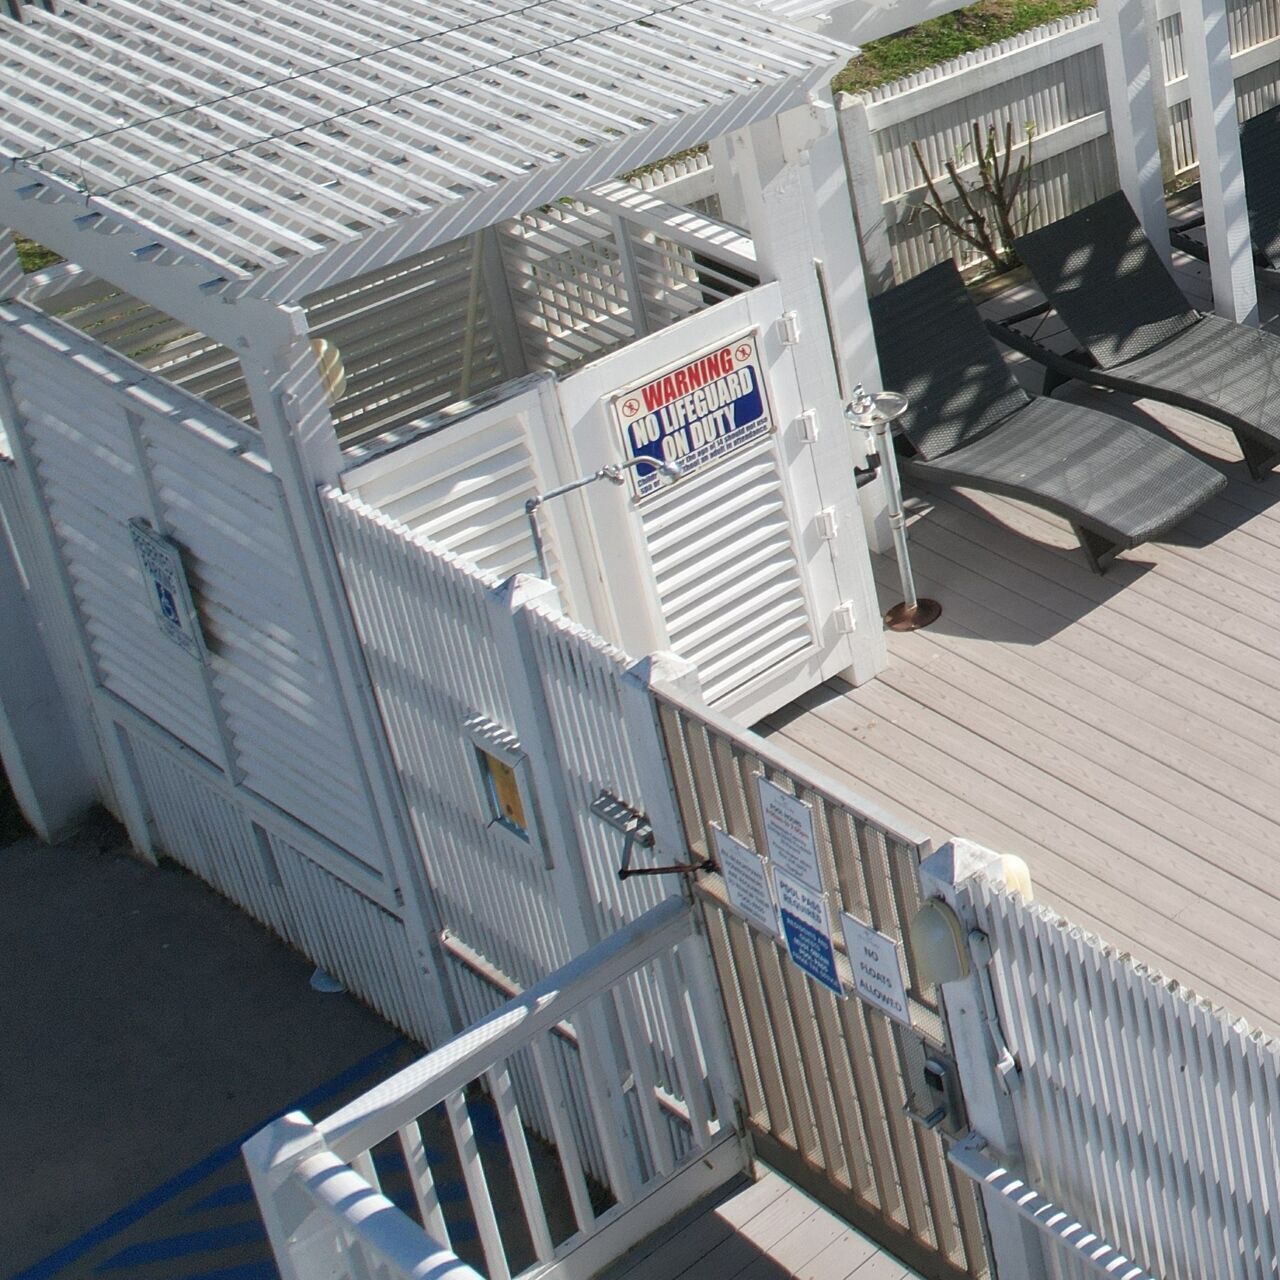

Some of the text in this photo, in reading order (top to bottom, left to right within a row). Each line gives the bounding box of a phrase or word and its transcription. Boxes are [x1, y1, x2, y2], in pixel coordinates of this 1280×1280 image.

[641, 348, 735, 413] WARNING
[632, 366, 754, 449] NO LIFEGUARD
[662, 404, 736, 462] ON DUTY
[780, 880, 822, 914] POOL PASS
[863, 946, 879, 962] NO
[860, 961, 893, 989] FLOATS
[859, 978, 902, 1012] ALLOWED
